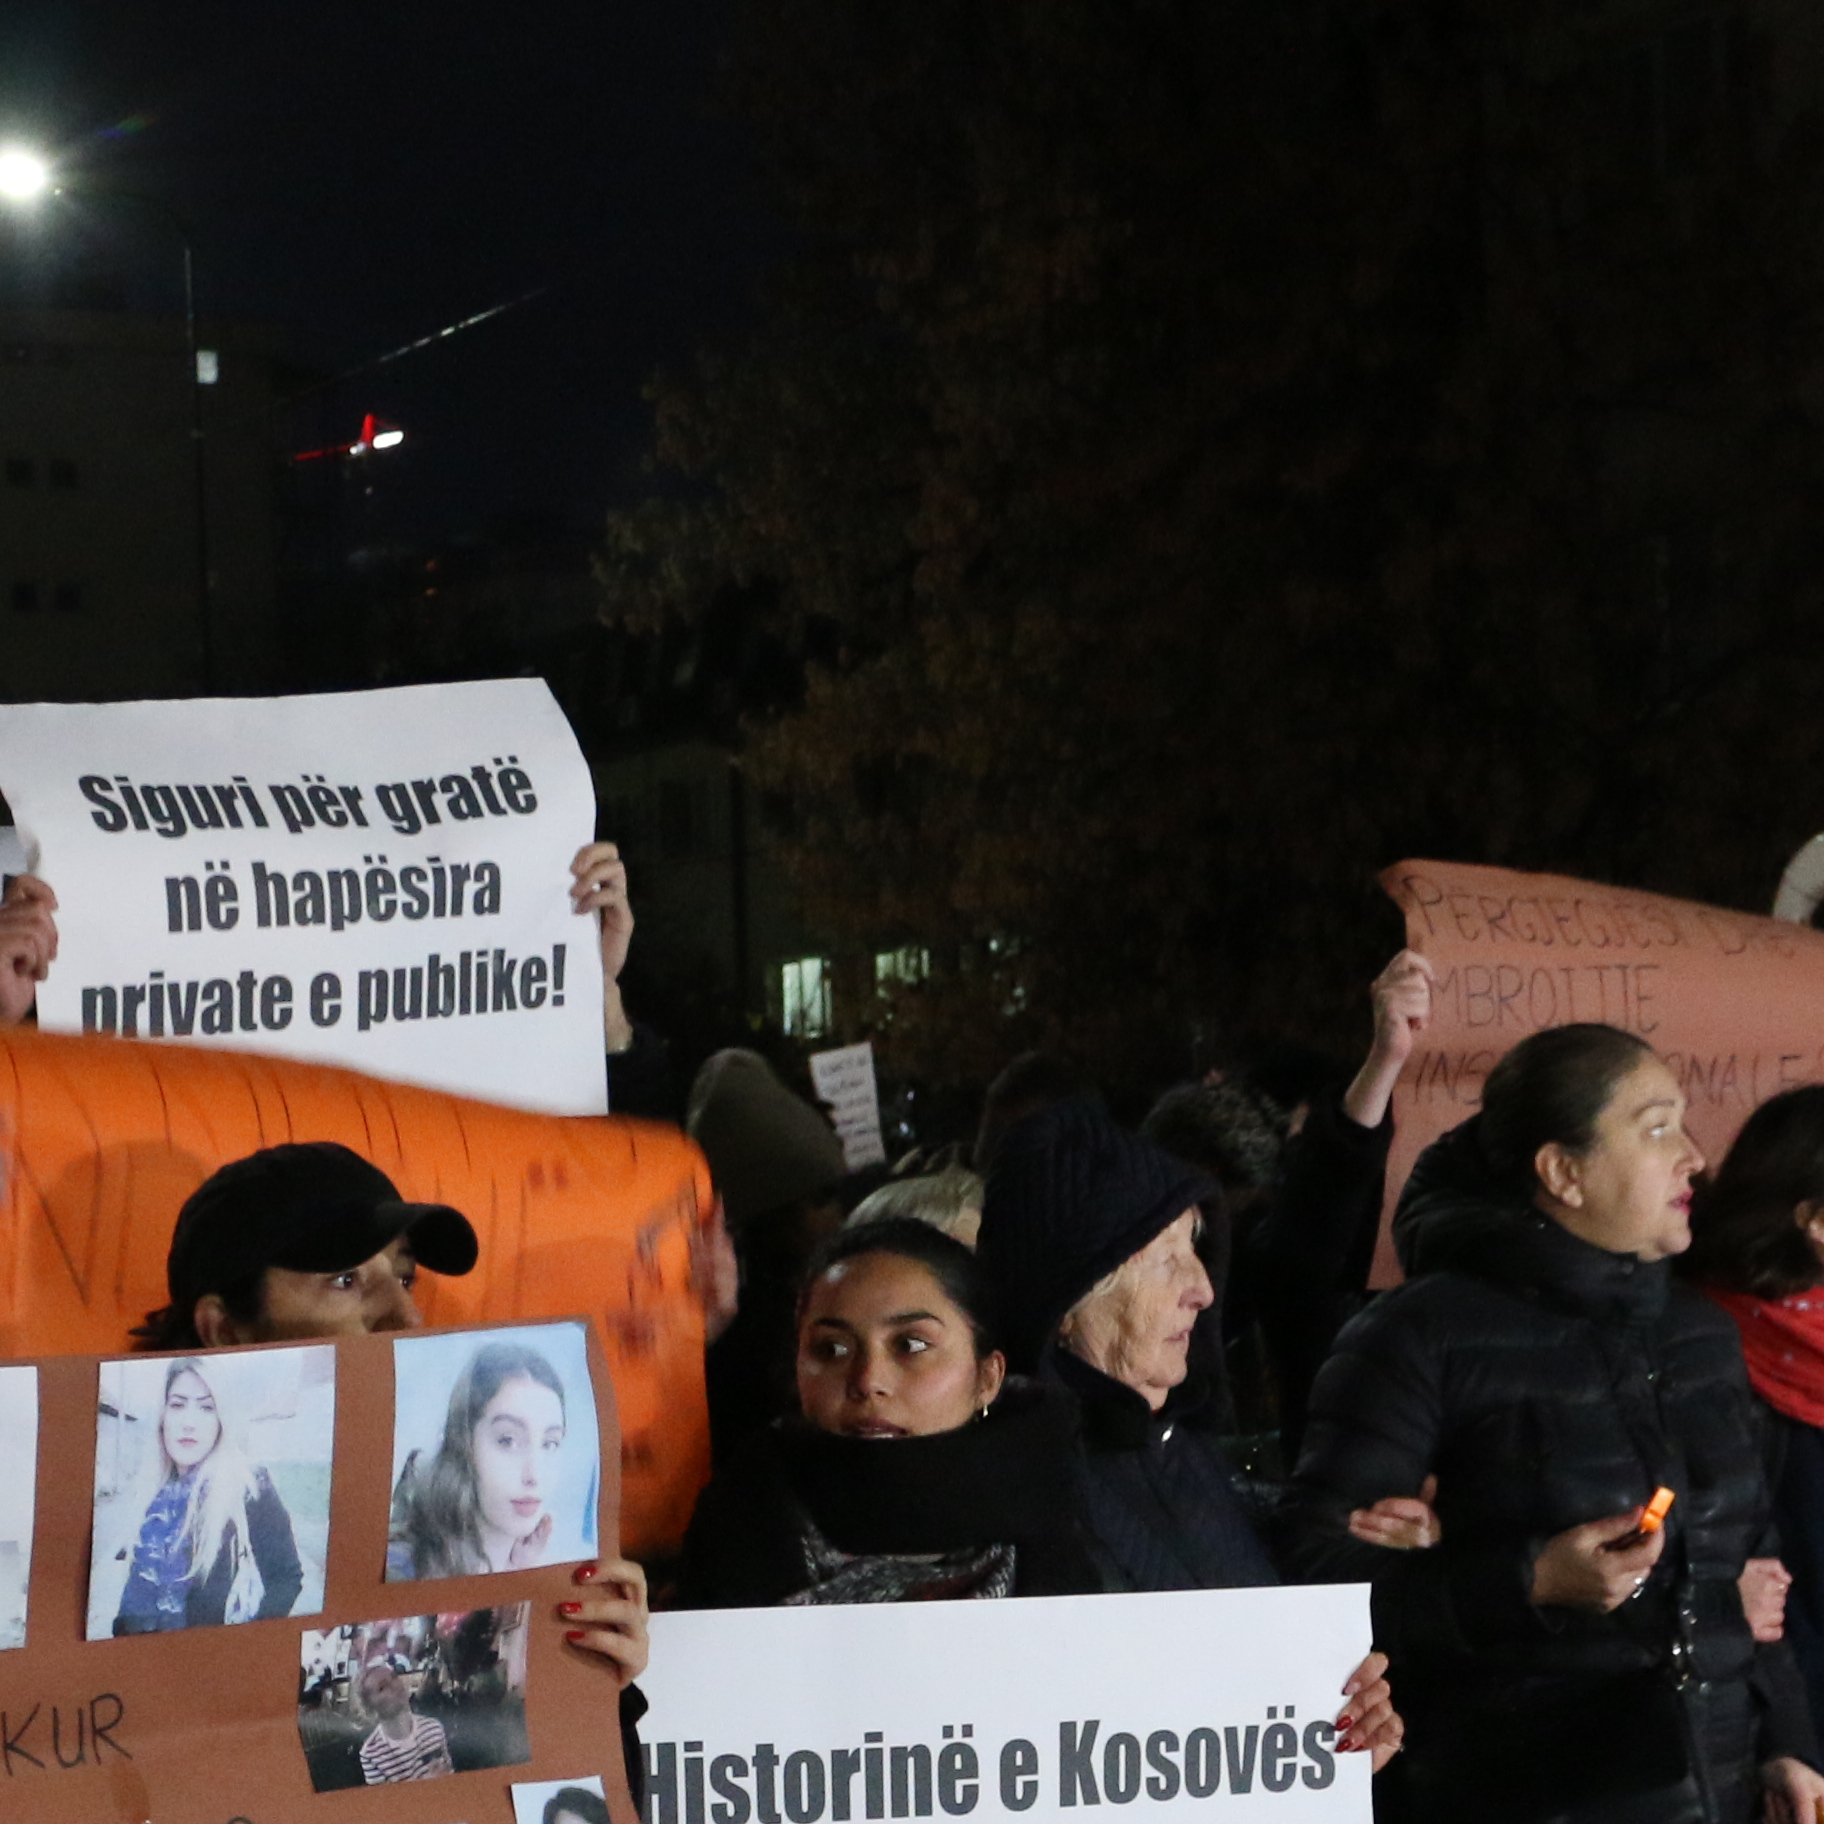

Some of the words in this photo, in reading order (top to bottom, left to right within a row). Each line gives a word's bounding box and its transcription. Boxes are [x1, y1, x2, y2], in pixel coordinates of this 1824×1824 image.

[79, 774, 269, 839] Siguri
[268, 774, 364, 832] për
[376, 756, 537, 835] gratë
[165, 861, 239, 932] në
[254, 856, 502, 932] hapësira
[82, 970, 293, 1037] private
[310, 981, 342, 1028] e
[357, 944, 566, 1032] publike!
[1, 1693, 133, 1776] KUR
[999, 1738, 1039, 1813] e
[1059, 1705, 1337, 1808] Kosovës
